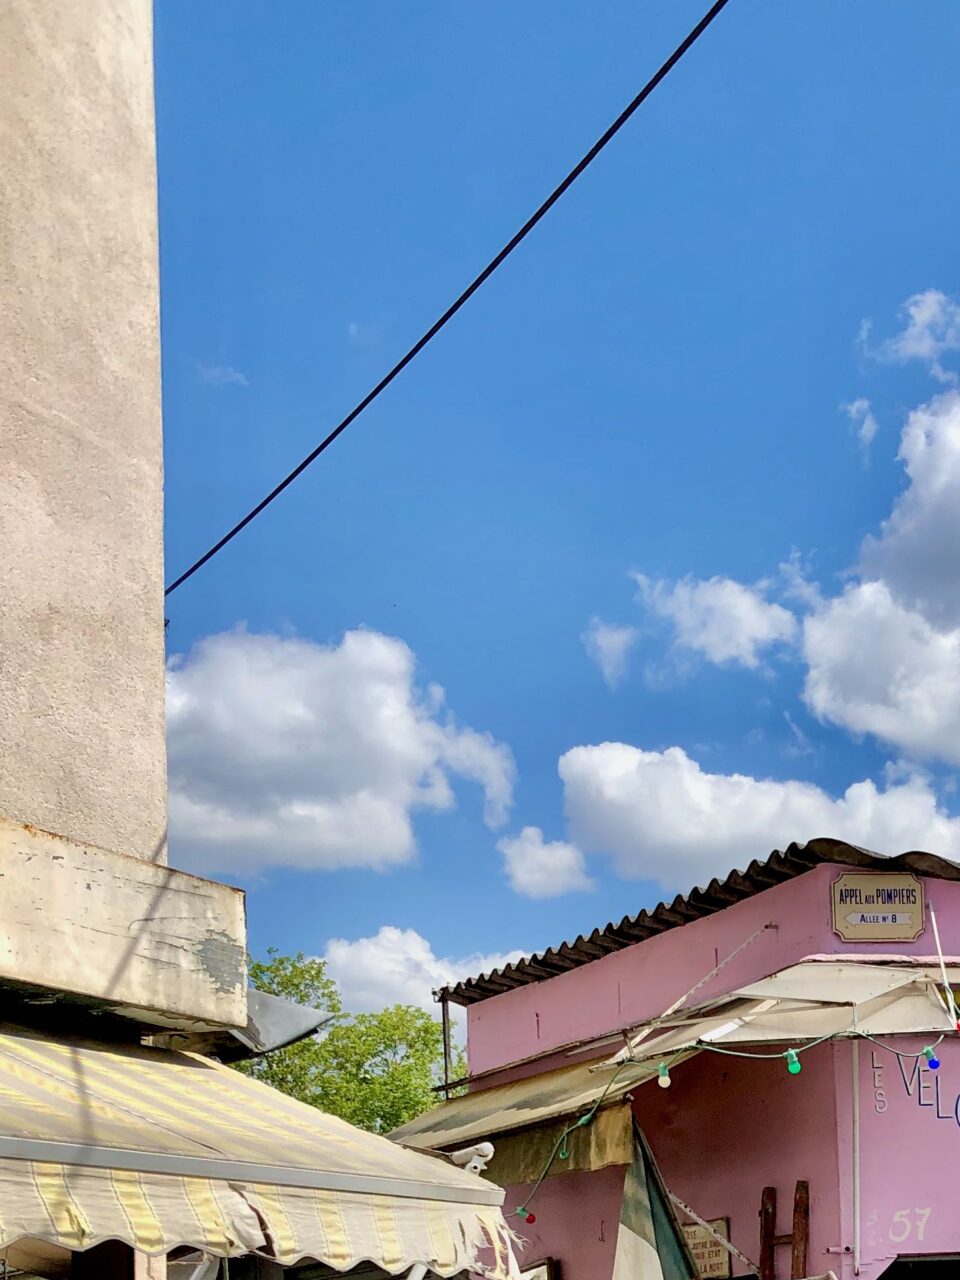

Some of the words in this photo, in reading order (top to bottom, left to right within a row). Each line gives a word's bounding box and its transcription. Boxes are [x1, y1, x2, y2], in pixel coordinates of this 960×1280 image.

[839, 888, 863, 904] APPEL
[876, 888, 917, 904] POMPIERS
[891, 914, 897, 923] 8
[871, 1051, 888, 1114] LES
[888, 1207, 932, 1243] 57
